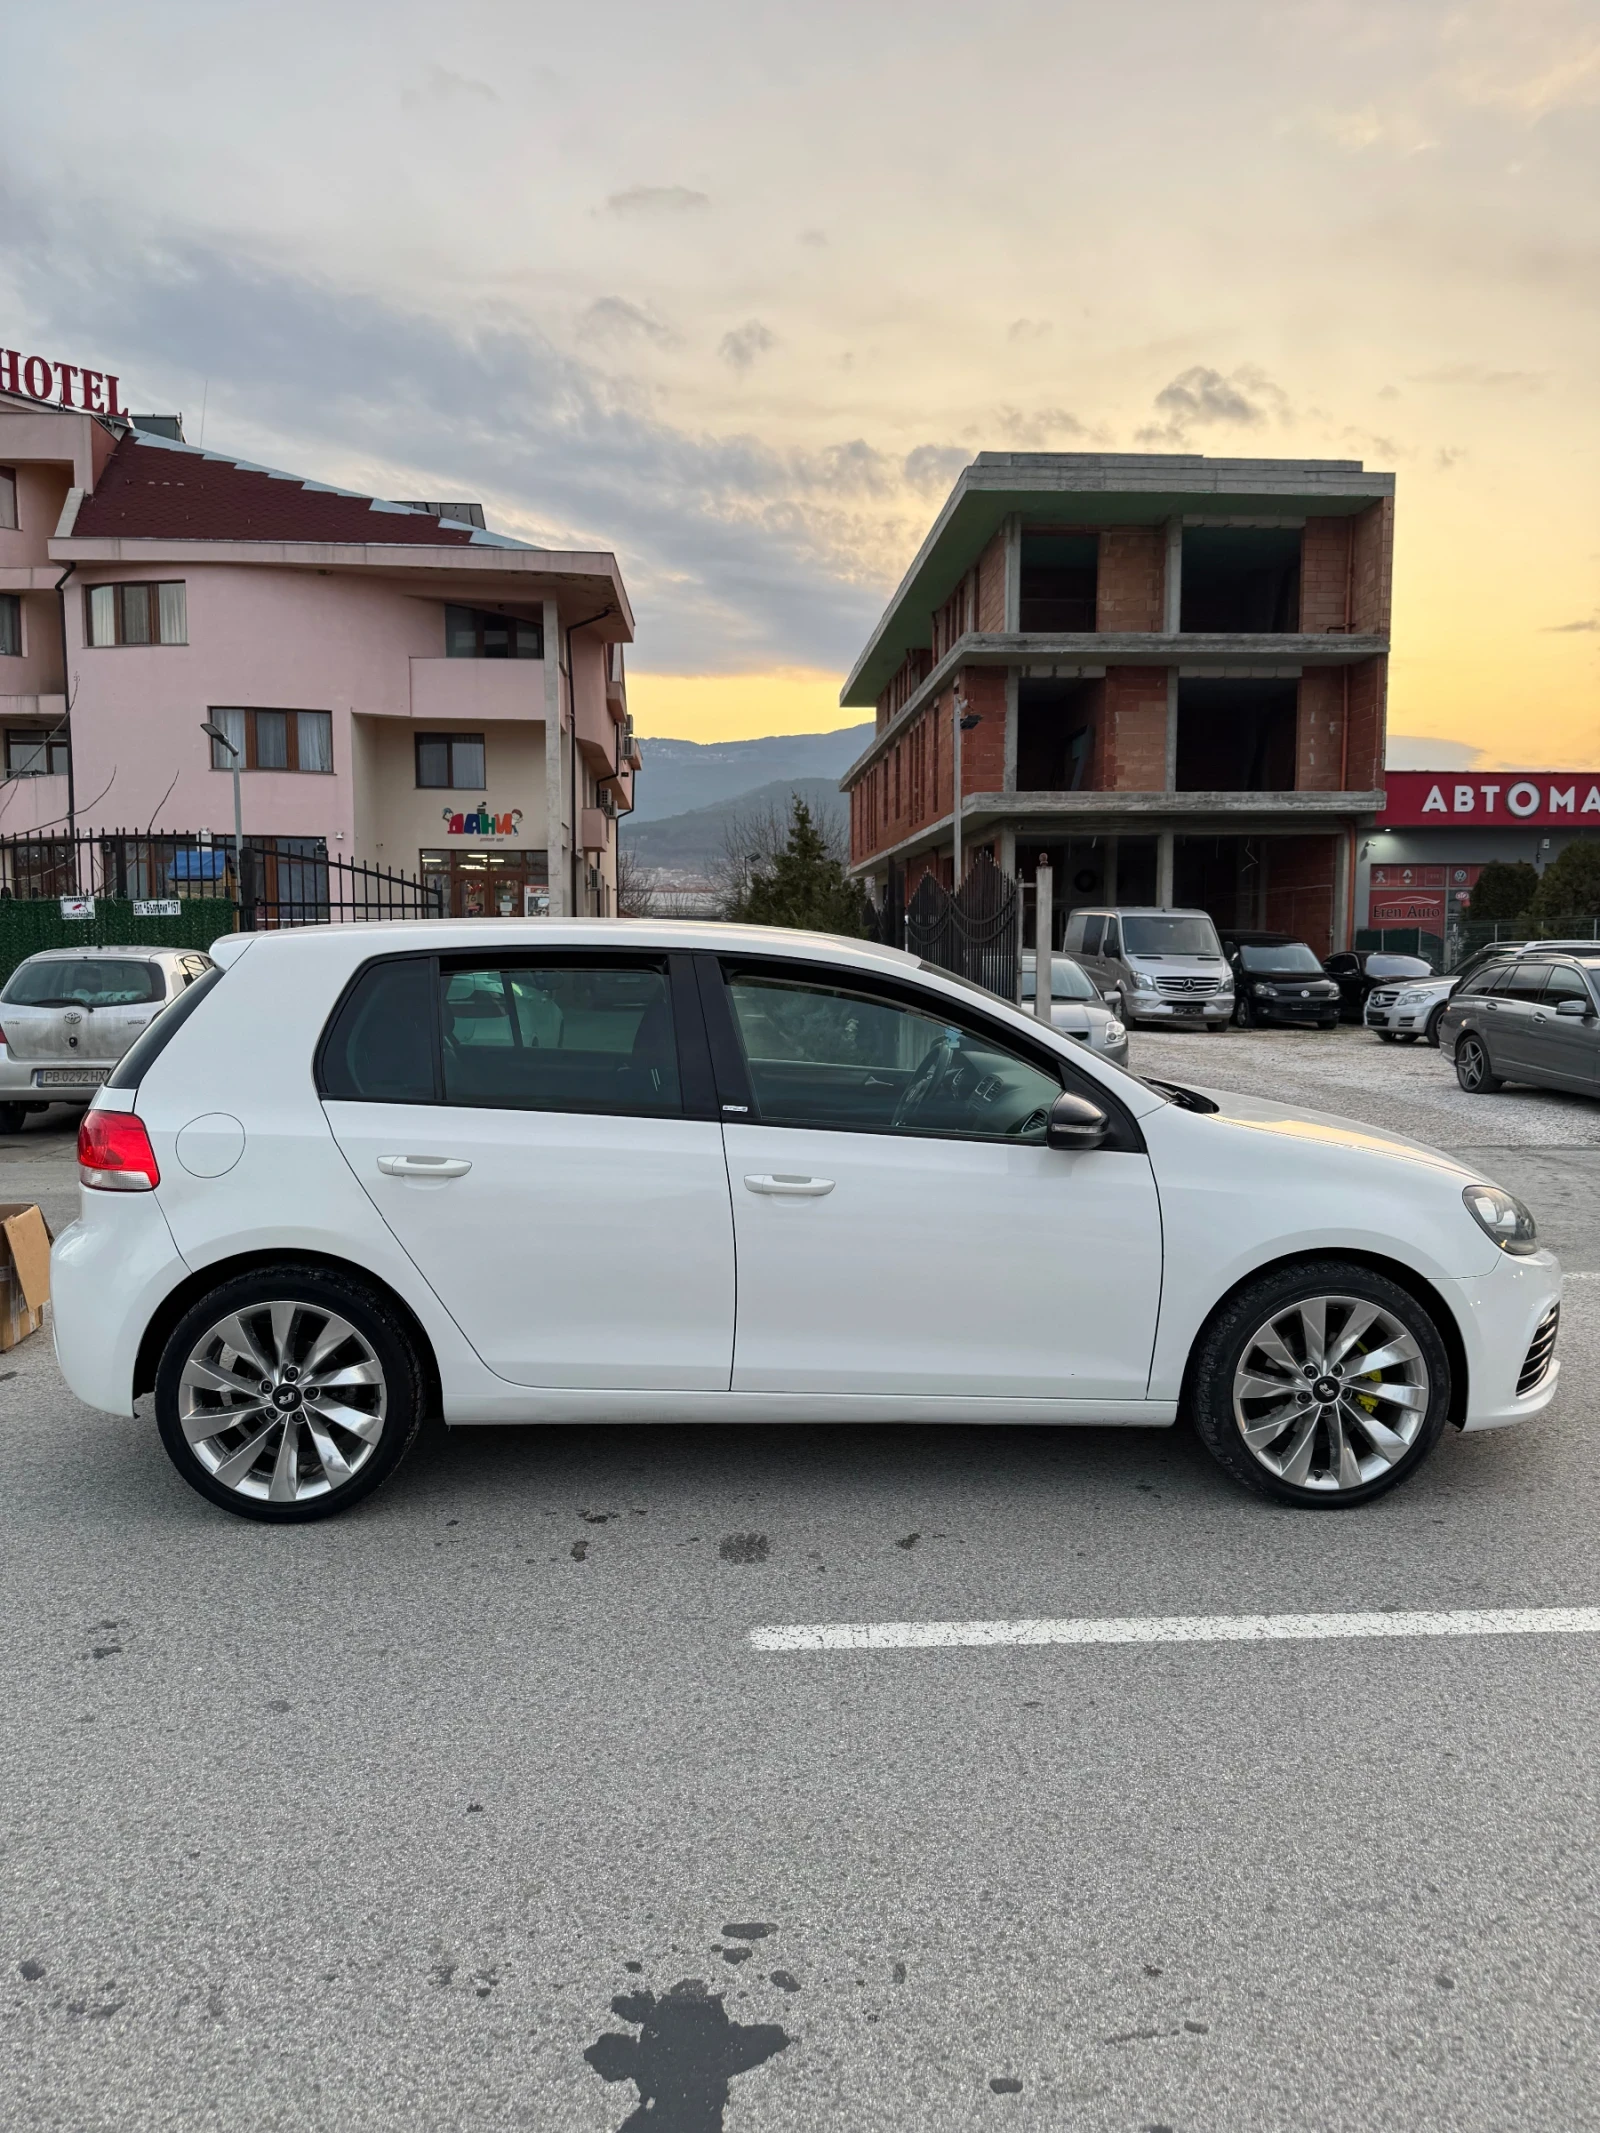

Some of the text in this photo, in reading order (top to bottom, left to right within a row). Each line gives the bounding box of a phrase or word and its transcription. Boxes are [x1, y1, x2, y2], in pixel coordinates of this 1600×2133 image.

[0, 348, 128, 418] HOTEL
[447, 813, 513, 835] ДАНИ
[1373, 905, 1440, 918] Eren Auto
